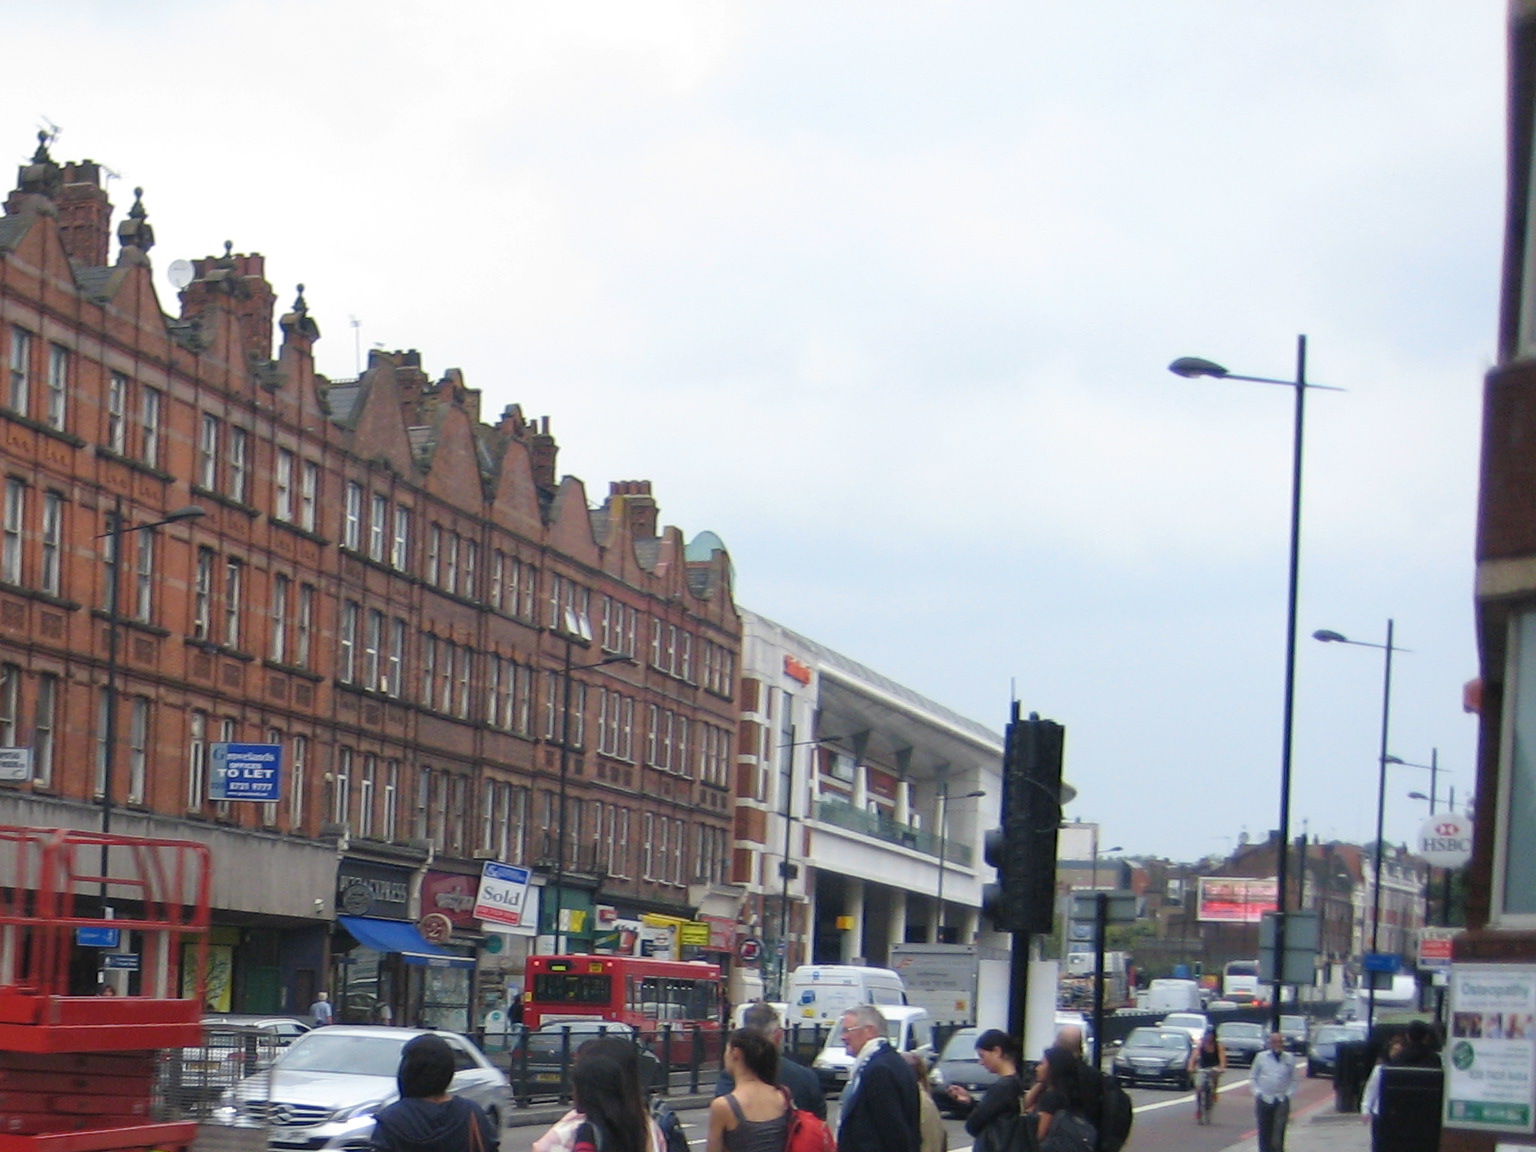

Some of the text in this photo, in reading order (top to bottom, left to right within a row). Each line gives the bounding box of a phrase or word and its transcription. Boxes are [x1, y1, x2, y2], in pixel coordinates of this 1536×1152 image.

[216, 769, 274, 778] TO LET
[1423, 838, 1470, 851] HSBC
[483, 886, 521, 906] Sold
